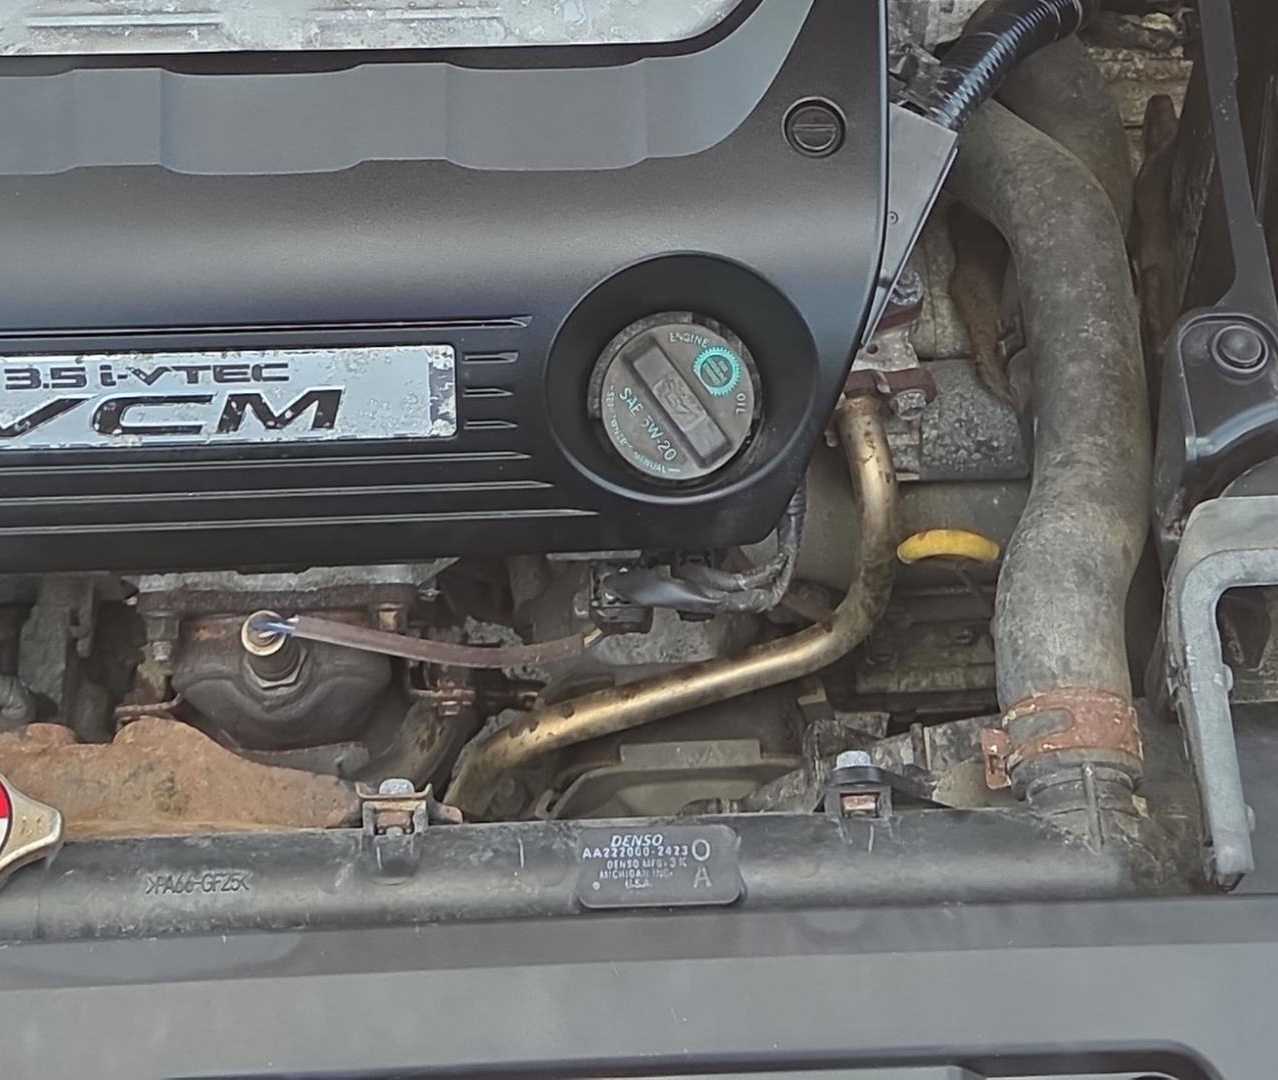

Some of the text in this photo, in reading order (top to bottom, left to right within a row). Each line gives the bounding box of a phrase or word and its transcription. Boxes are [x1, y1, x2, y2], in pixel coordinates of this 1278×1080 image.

[670, 331, 710, 348] ENGINE
[4, 362, 289, 390] 3.5 i-VTEC
[735, 392, 748, 415] OIL
[620, 387, 677, 461] SAE 5W-20
[610, 834, 663, 847] DENSO
[582, 846, 688, 859] AA222000-2423
[607, 859, 639, 870] DENSO
[693, 866, 712, 888] A
